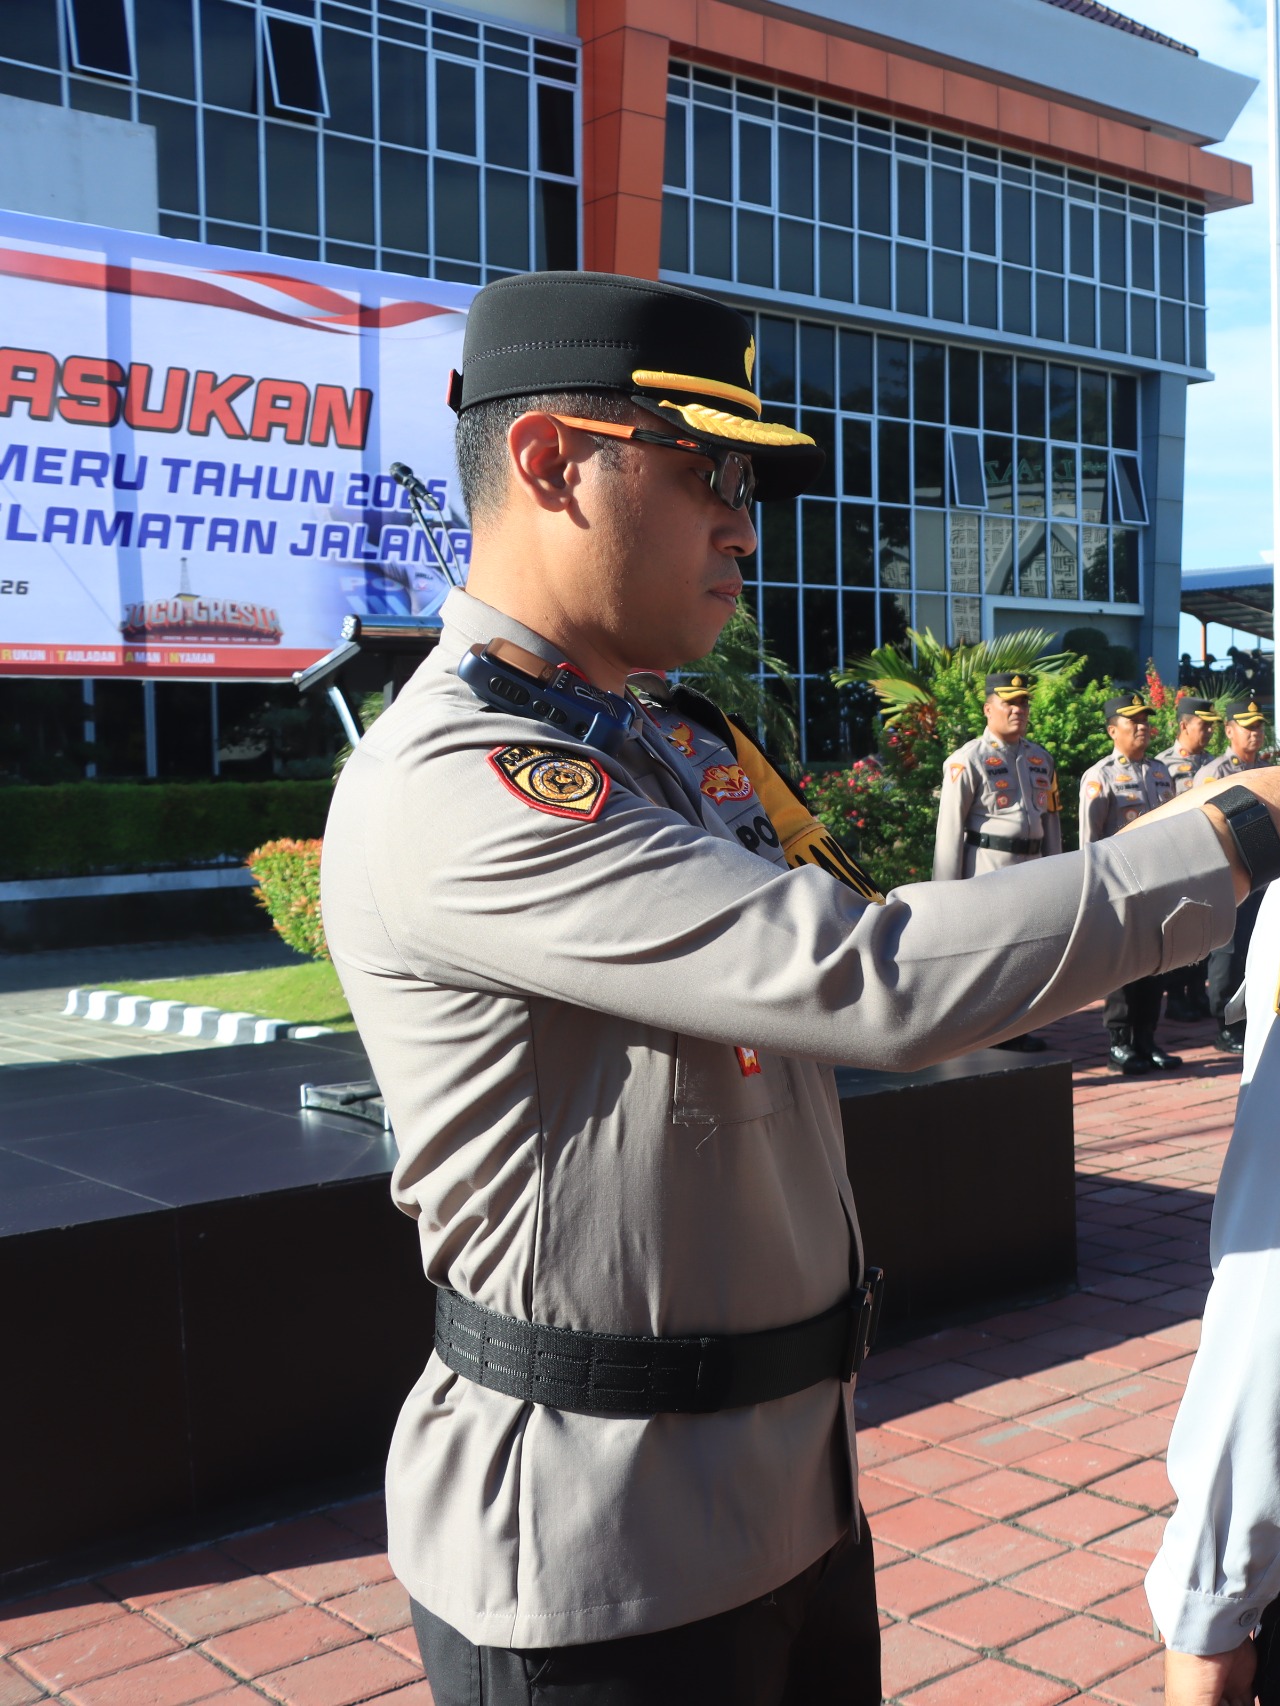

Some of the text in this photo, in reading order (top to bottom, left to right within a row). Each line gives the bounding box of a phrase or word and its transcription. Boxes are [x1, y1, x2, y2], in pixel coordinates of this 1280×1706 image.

[0, 346, 373, 450] ASUKAN
[161, 457, 334, 504] TAHUN
[0, 503, 277, 555] LAMATAN
[2, 649, 46, 661] RUKUN
[125, 652, 160, 663] AMAN
[169, 653, 215, 664] NYAMAN
